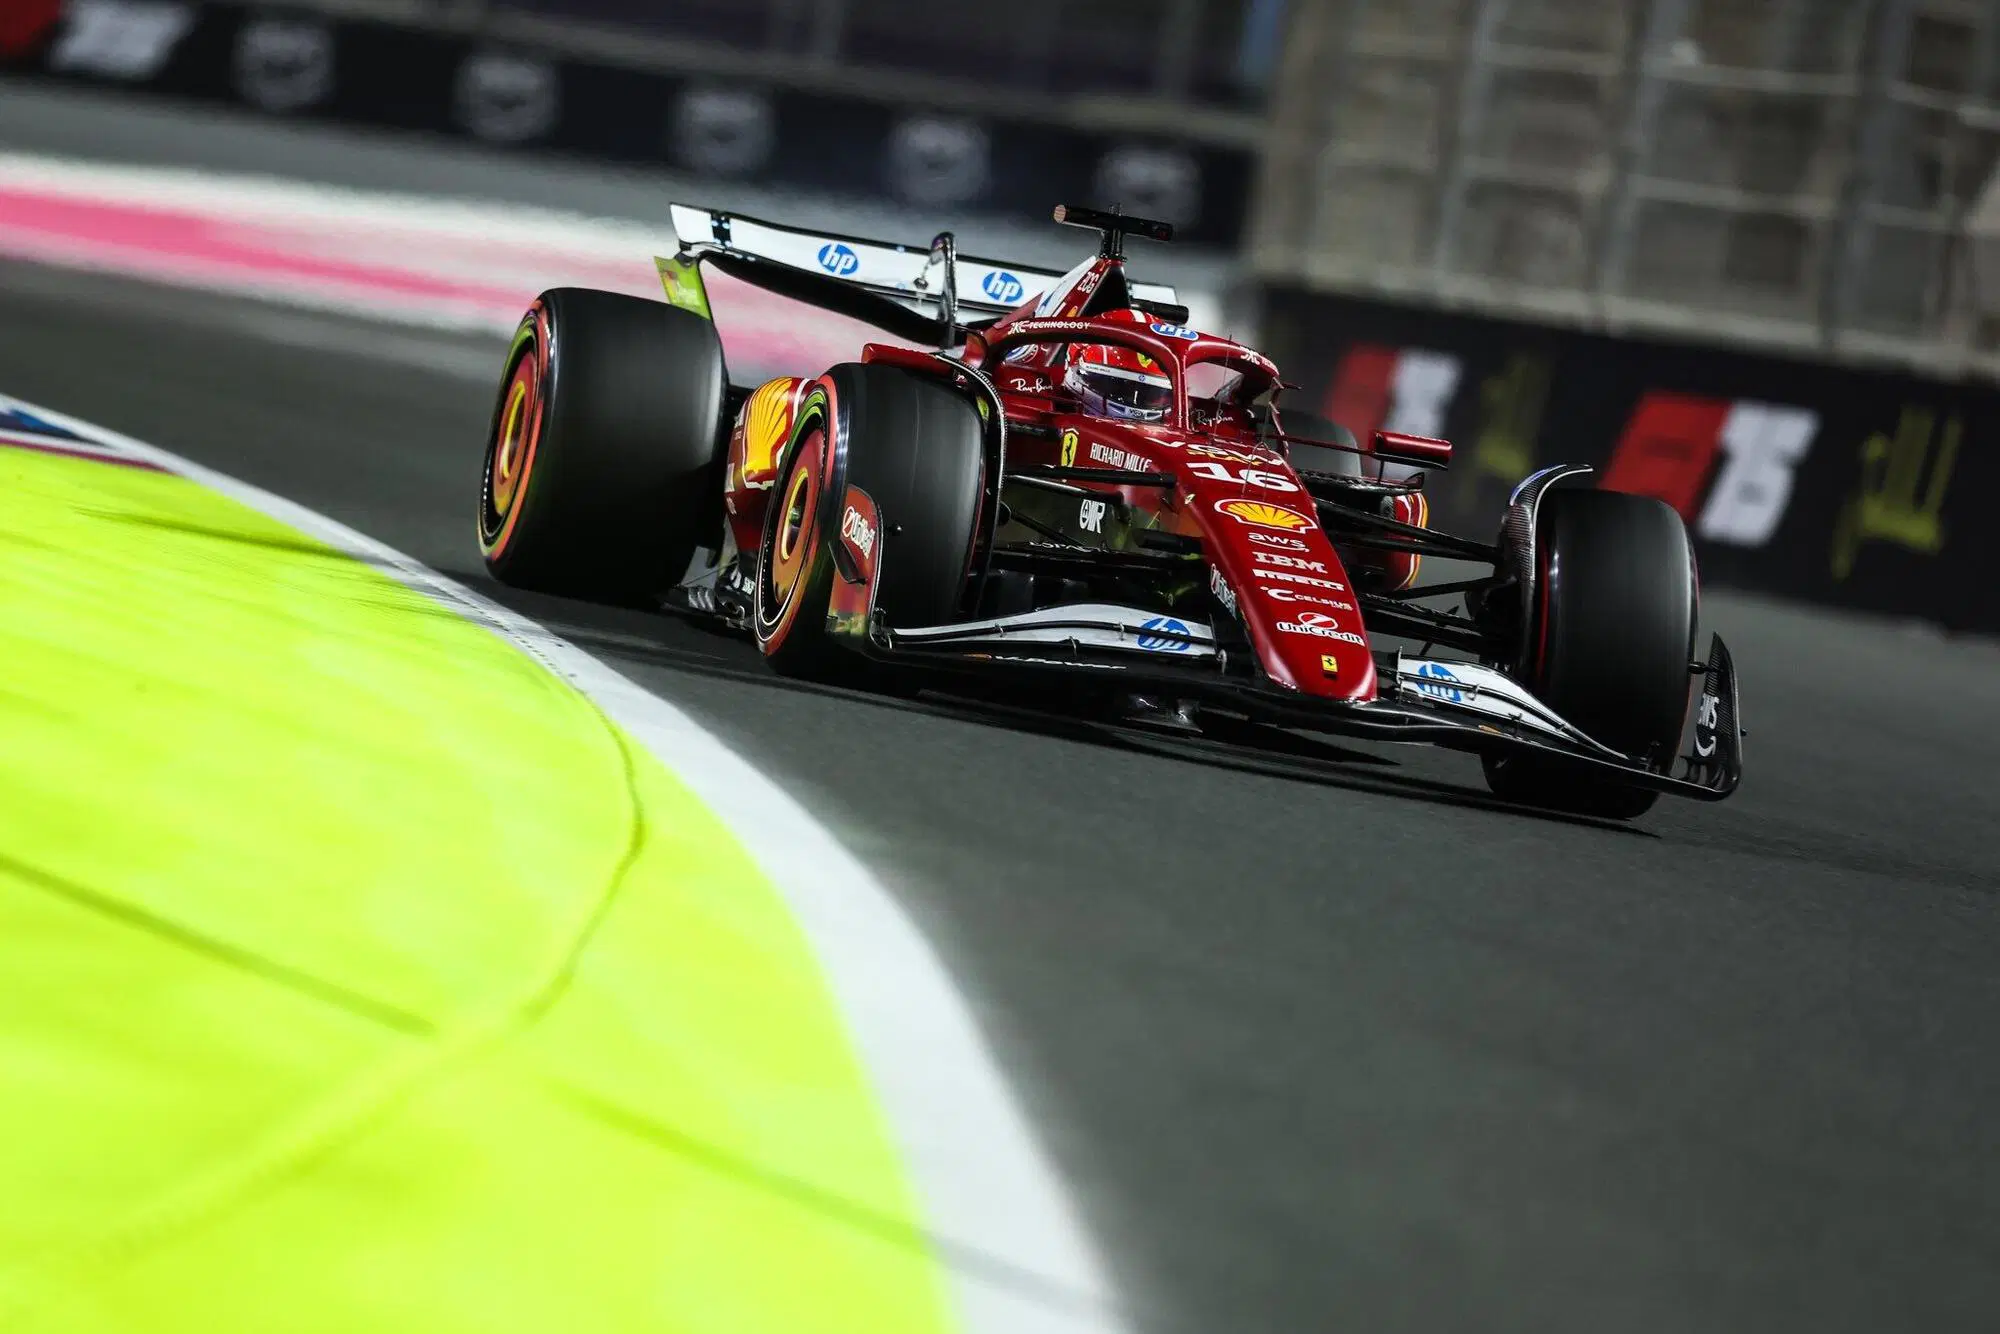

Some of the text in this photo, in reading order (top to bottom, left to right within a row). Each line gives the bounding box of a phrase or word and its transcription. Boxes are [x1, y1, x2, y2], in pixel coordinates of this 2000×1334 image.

[822, 243, 856, 275] hp
[986, 271, 1021, 302] hp
[1029, 321, 1091, 329] TECHNOLOGY
[1156, 323, 1194, 340] hp
[1010, 378, 1053, 393] Ray-Ban
[1089, 442, 1153, 473] RICHARD MILLE
[1186, 462, 1299, 492] 16
[1248, 532, 1306, 549] aws
[1252, 551, 1328, 574] IBM
[1276, 622, 1365, 647] UniCredit
